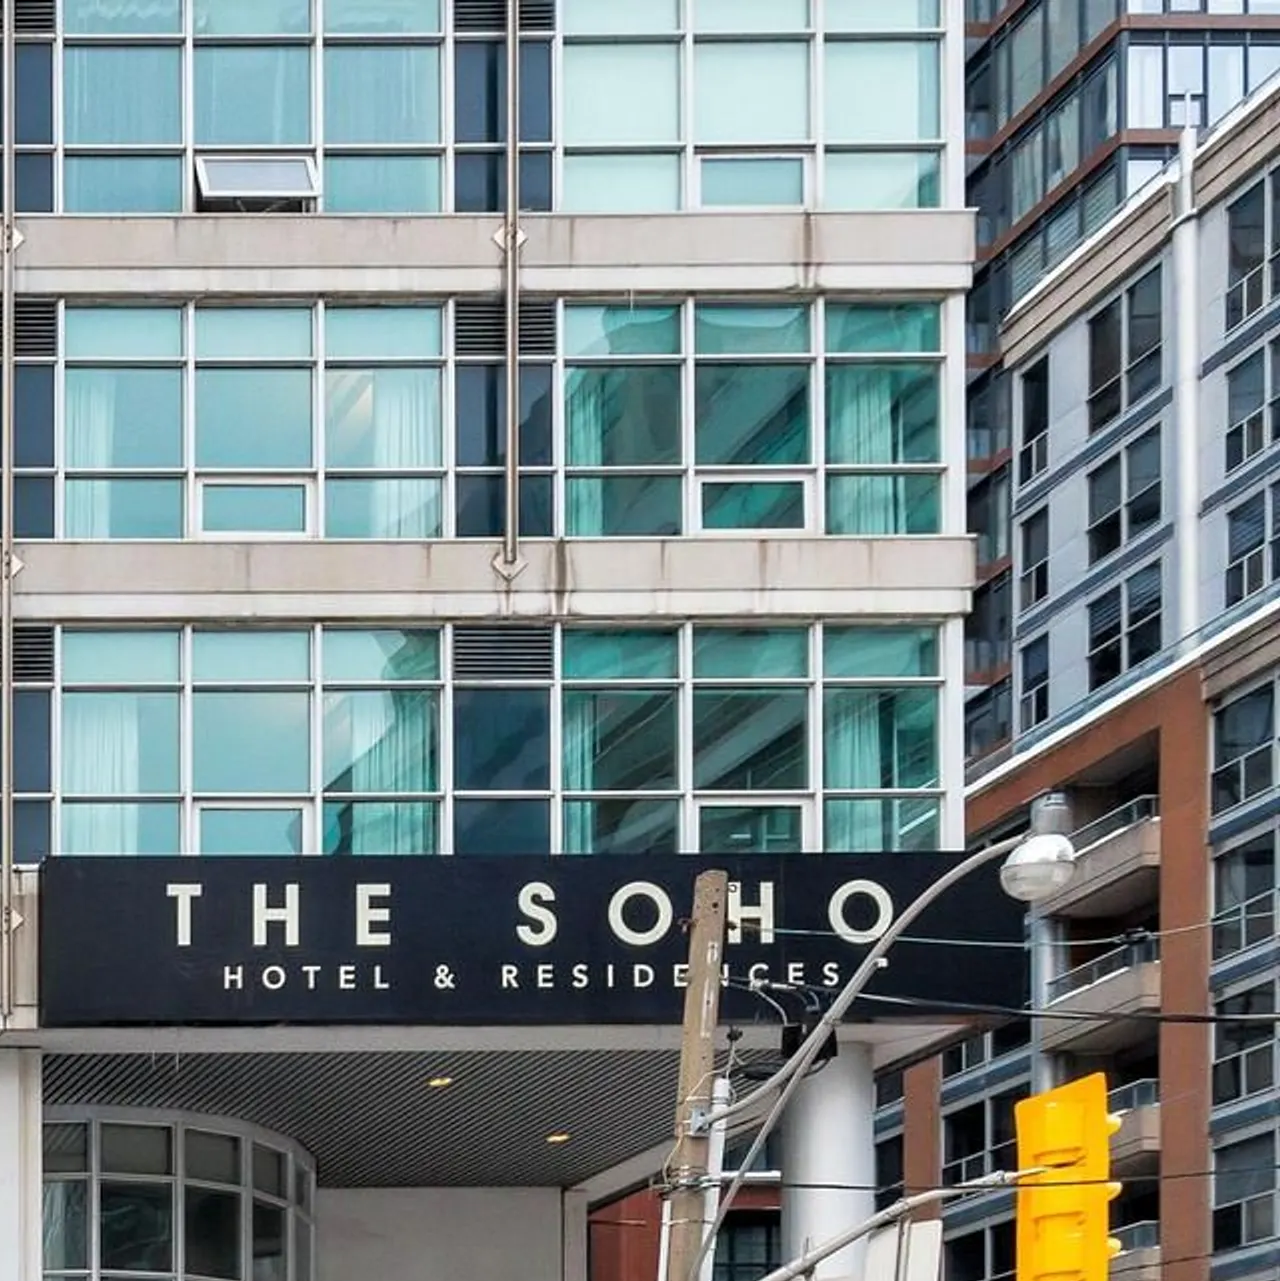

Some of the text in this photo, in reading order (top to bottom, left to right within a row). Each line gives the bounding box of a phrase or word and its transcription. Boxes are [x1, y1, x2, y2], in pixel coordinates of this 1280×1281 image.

[166, 879, 894, 946] THE SOHO
[223, 965, 390, 989] HOTEL
[433, 965, 455, 989] &
